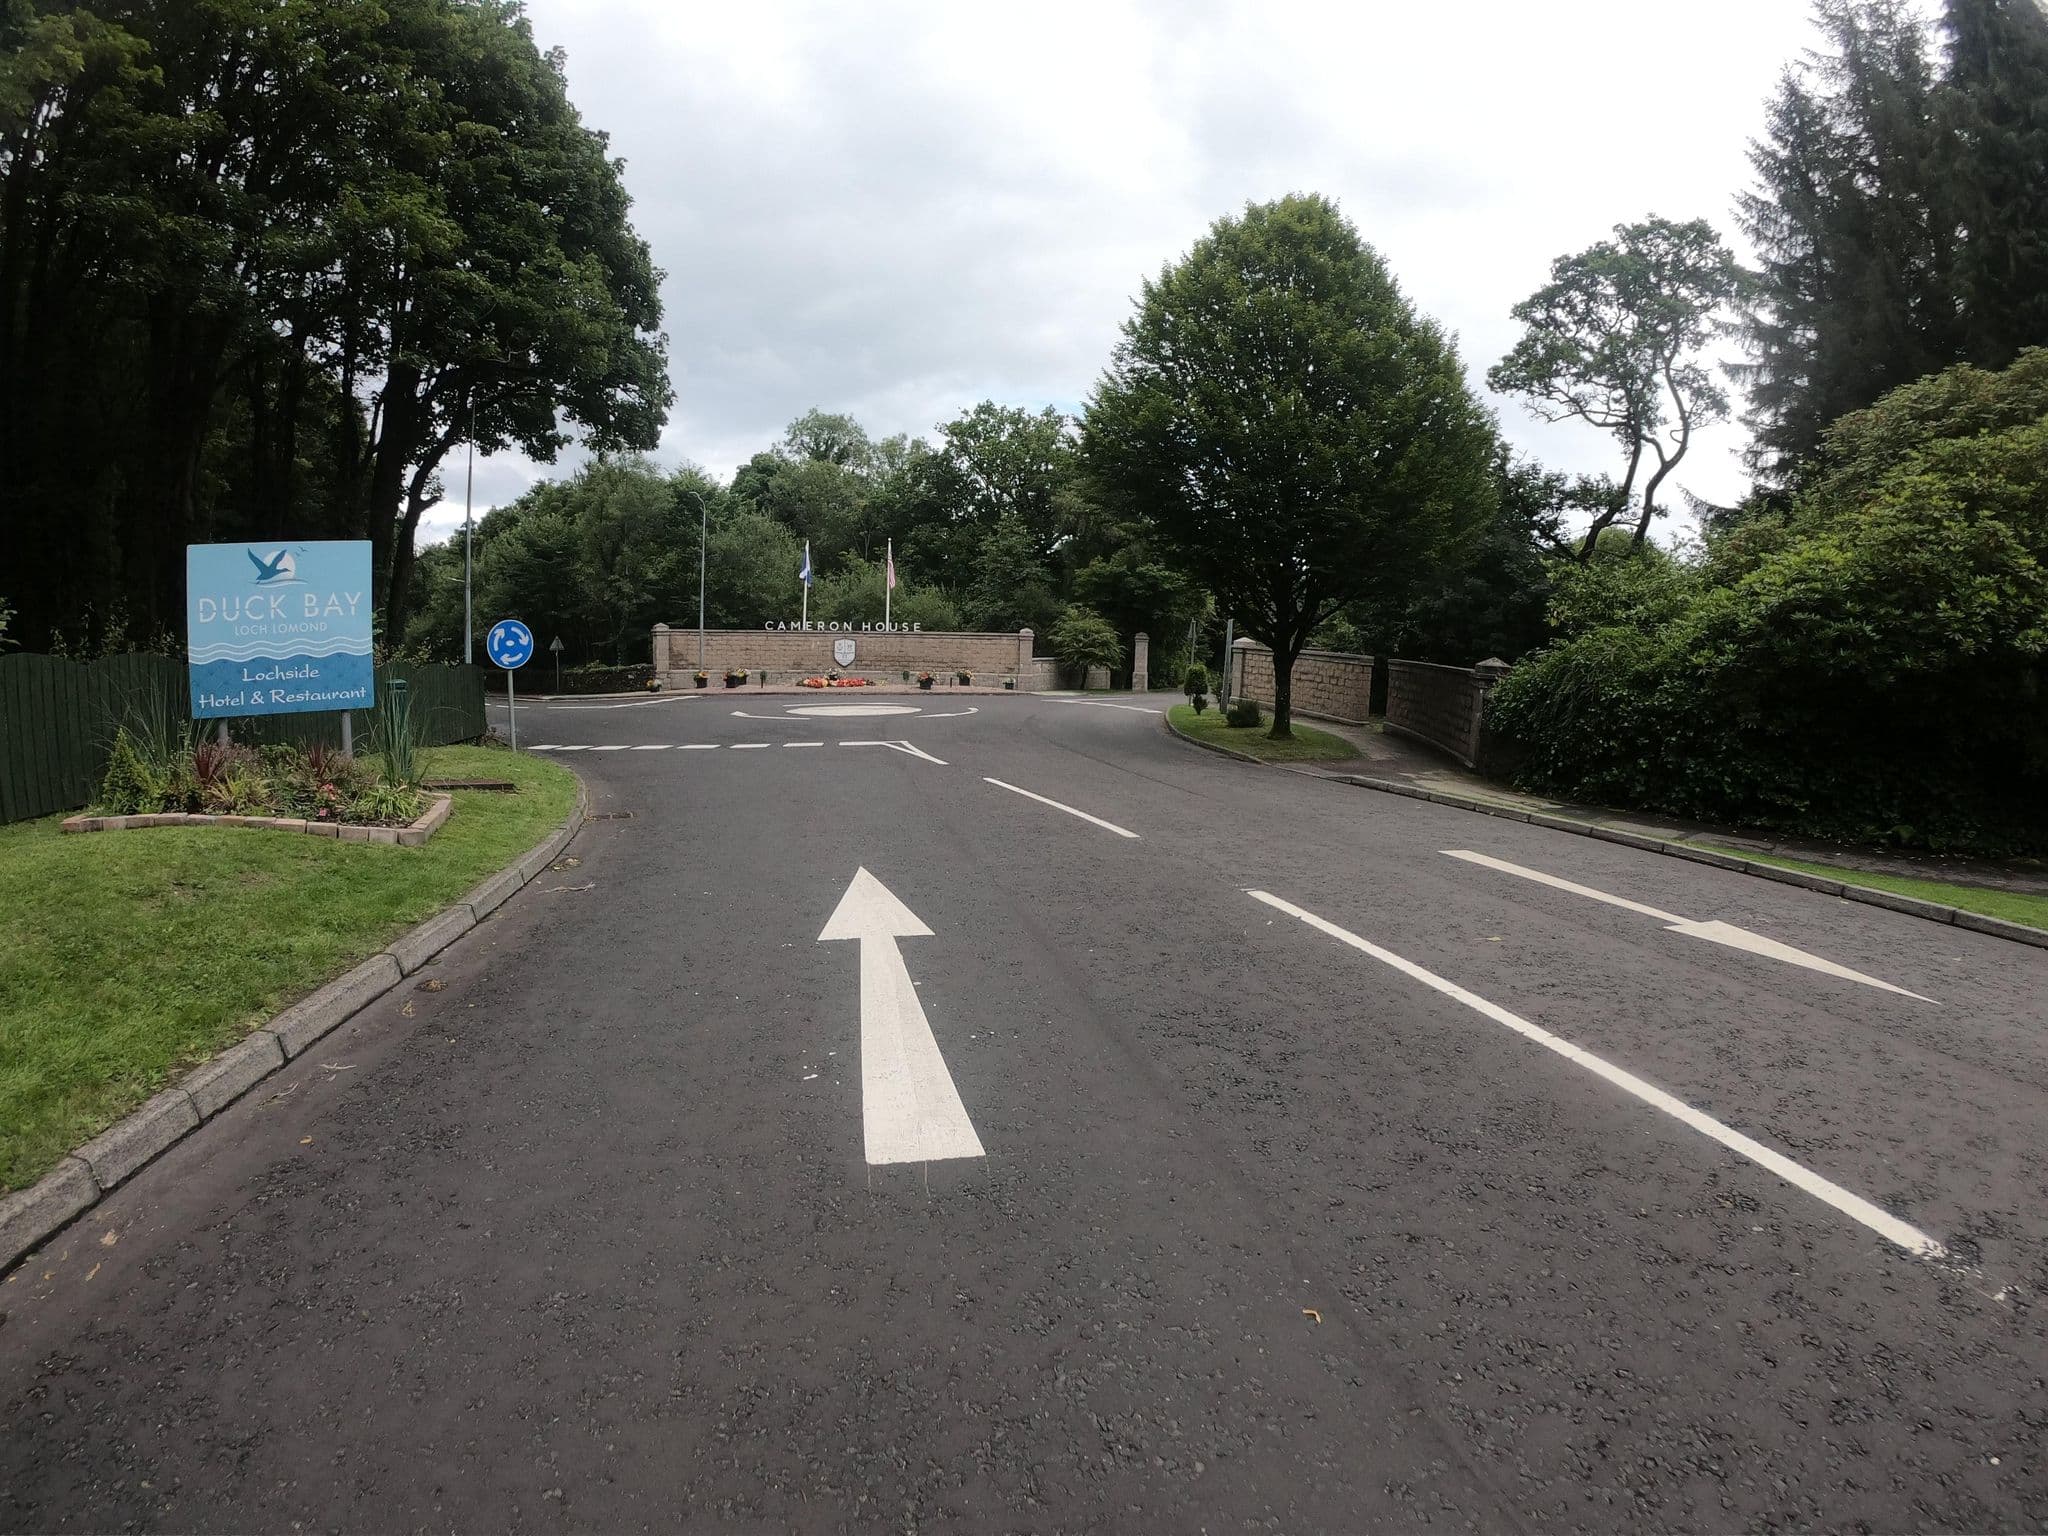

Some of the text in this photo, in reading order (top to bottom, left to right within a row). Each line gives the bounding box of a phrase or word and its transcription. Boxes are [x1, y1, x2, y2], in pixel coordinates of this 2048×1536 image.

[199, 591, 362, 623] DUCK BAY
[234, 622, 328, 636] LOCH LOMOND
[764, 620, 921, 632] CAMERON HOUSE
[242, 664, 320, 682] Lochside
[199, 687, 366, 709] Hotel & Restaurant
